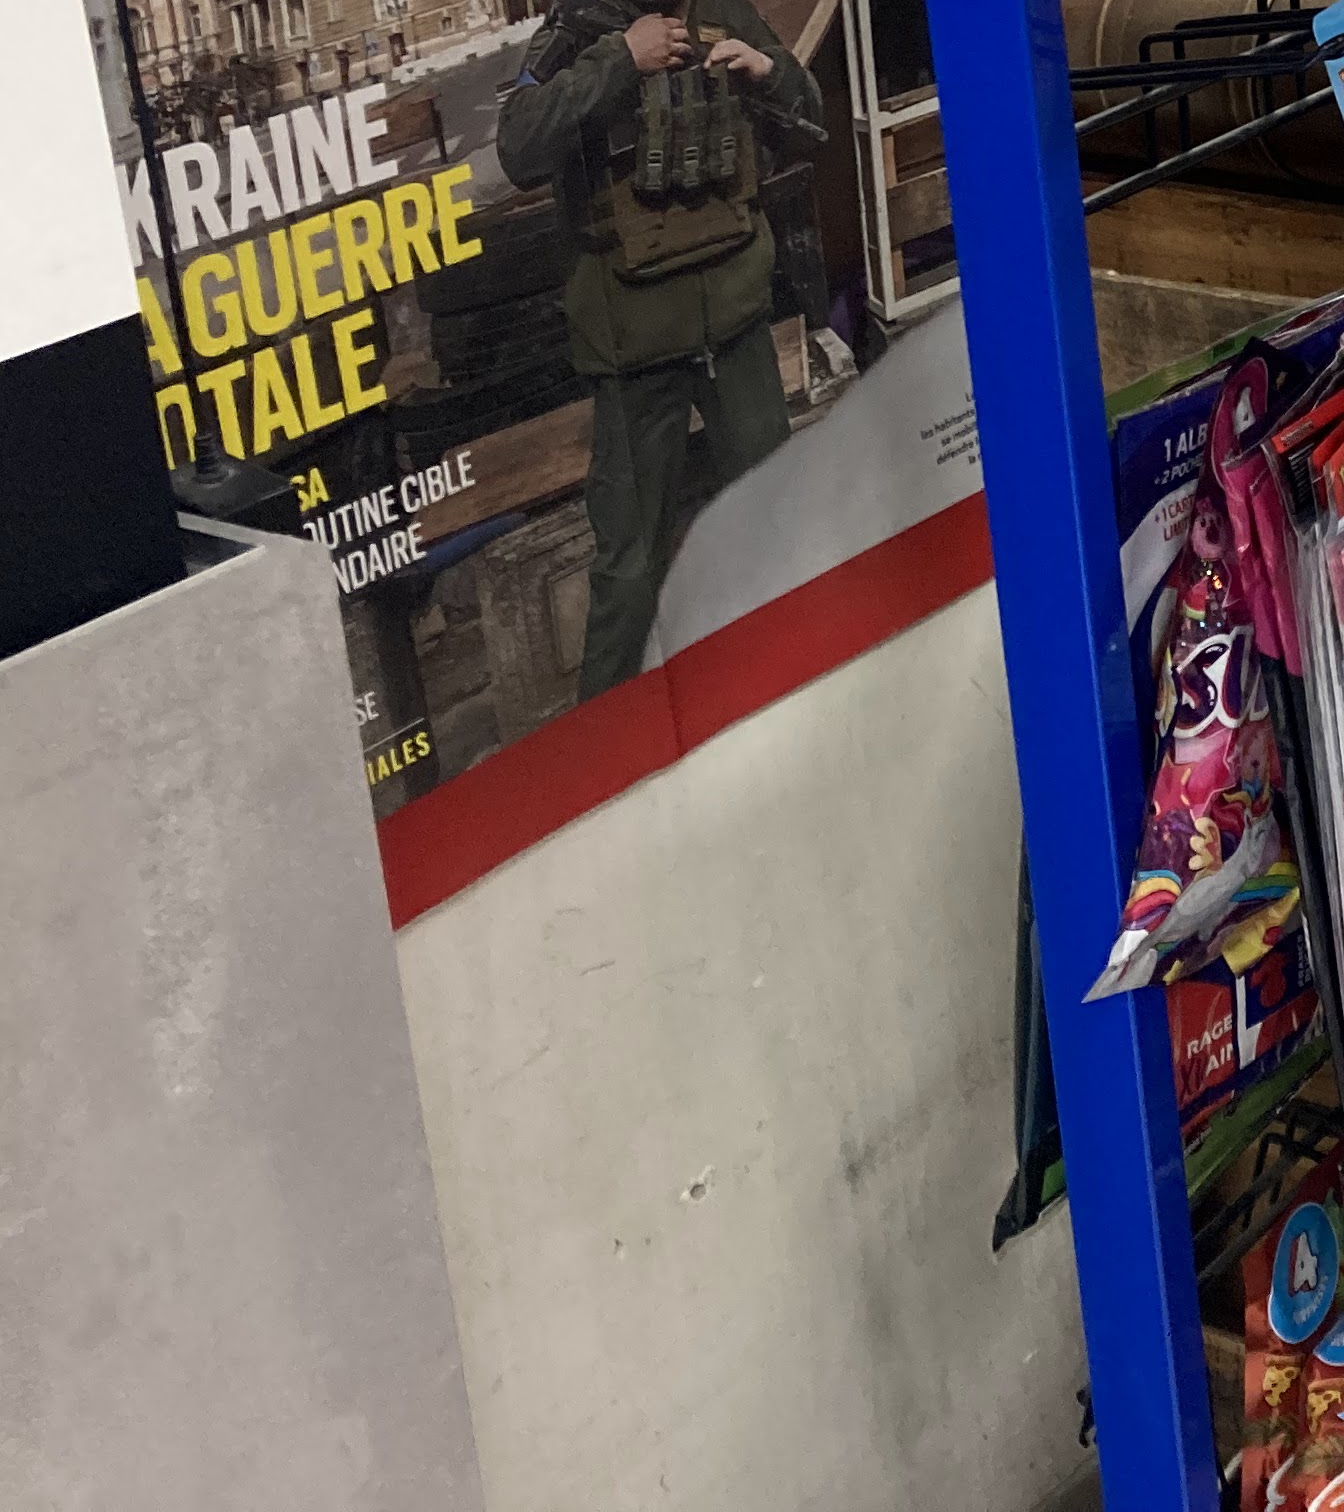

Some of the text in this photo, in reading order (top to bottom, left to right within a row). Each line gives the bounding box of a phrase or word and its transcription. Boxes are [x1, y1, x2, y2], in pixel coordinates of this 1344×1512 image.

[117, 83, 399, 267] KRAINE
[180, 164, 483, 357] GUERRE
[155, 309, 387, 470] OTALE
[304, 484, 399, 550] OUTINE
[400, 450, 476, 514] CIBLE
[332, 522, 427, 594] NDAIRE
